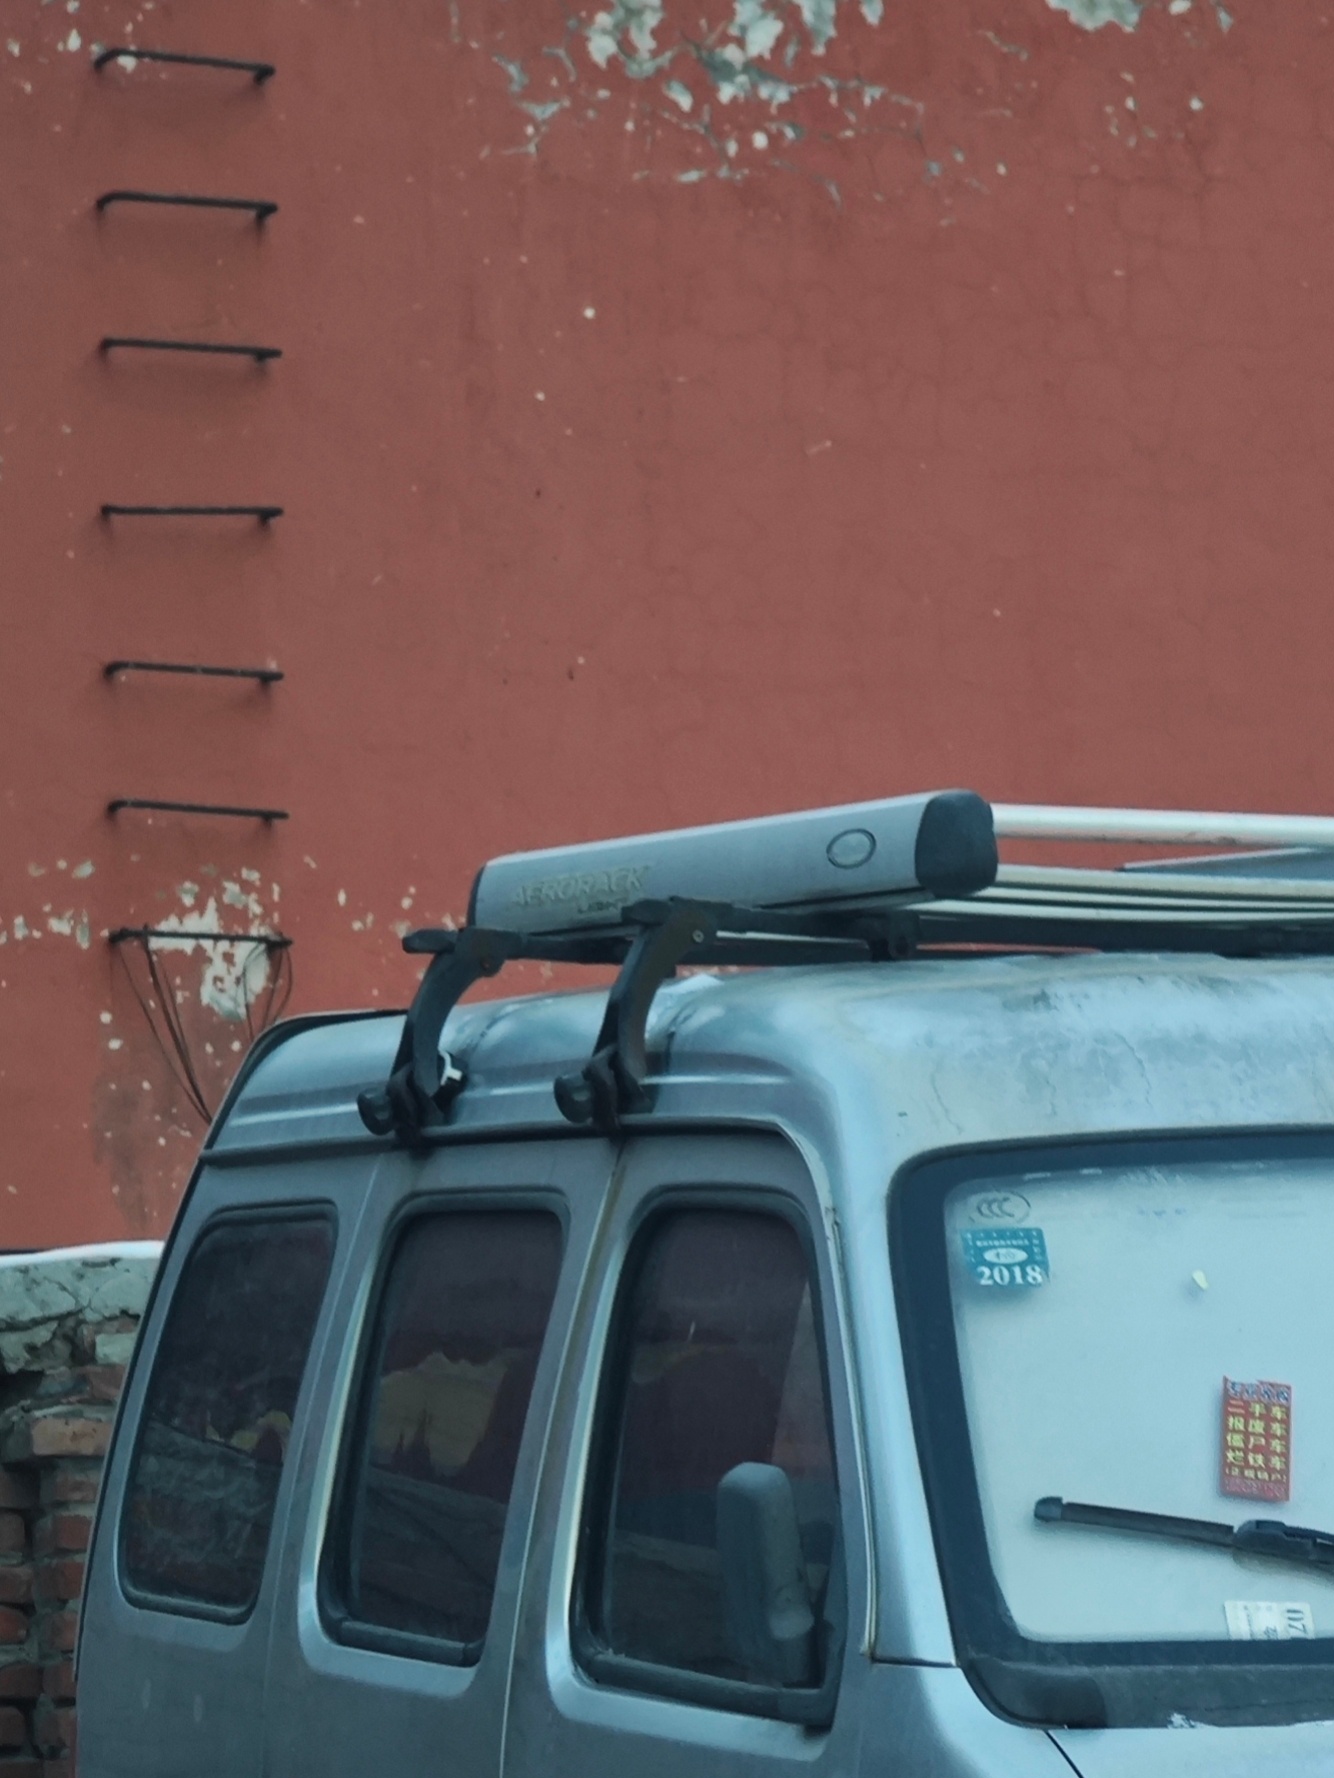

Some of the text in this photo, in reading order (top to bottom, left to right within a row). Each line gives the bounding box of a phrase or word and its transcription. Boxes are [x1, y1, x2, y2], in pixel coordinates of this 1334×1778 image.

[977, 1264, 1043, 1286] 2018
[1227, 1400, 1287, 1420] 二手车
[1227, 1416, 1287, 1436] 报废车
